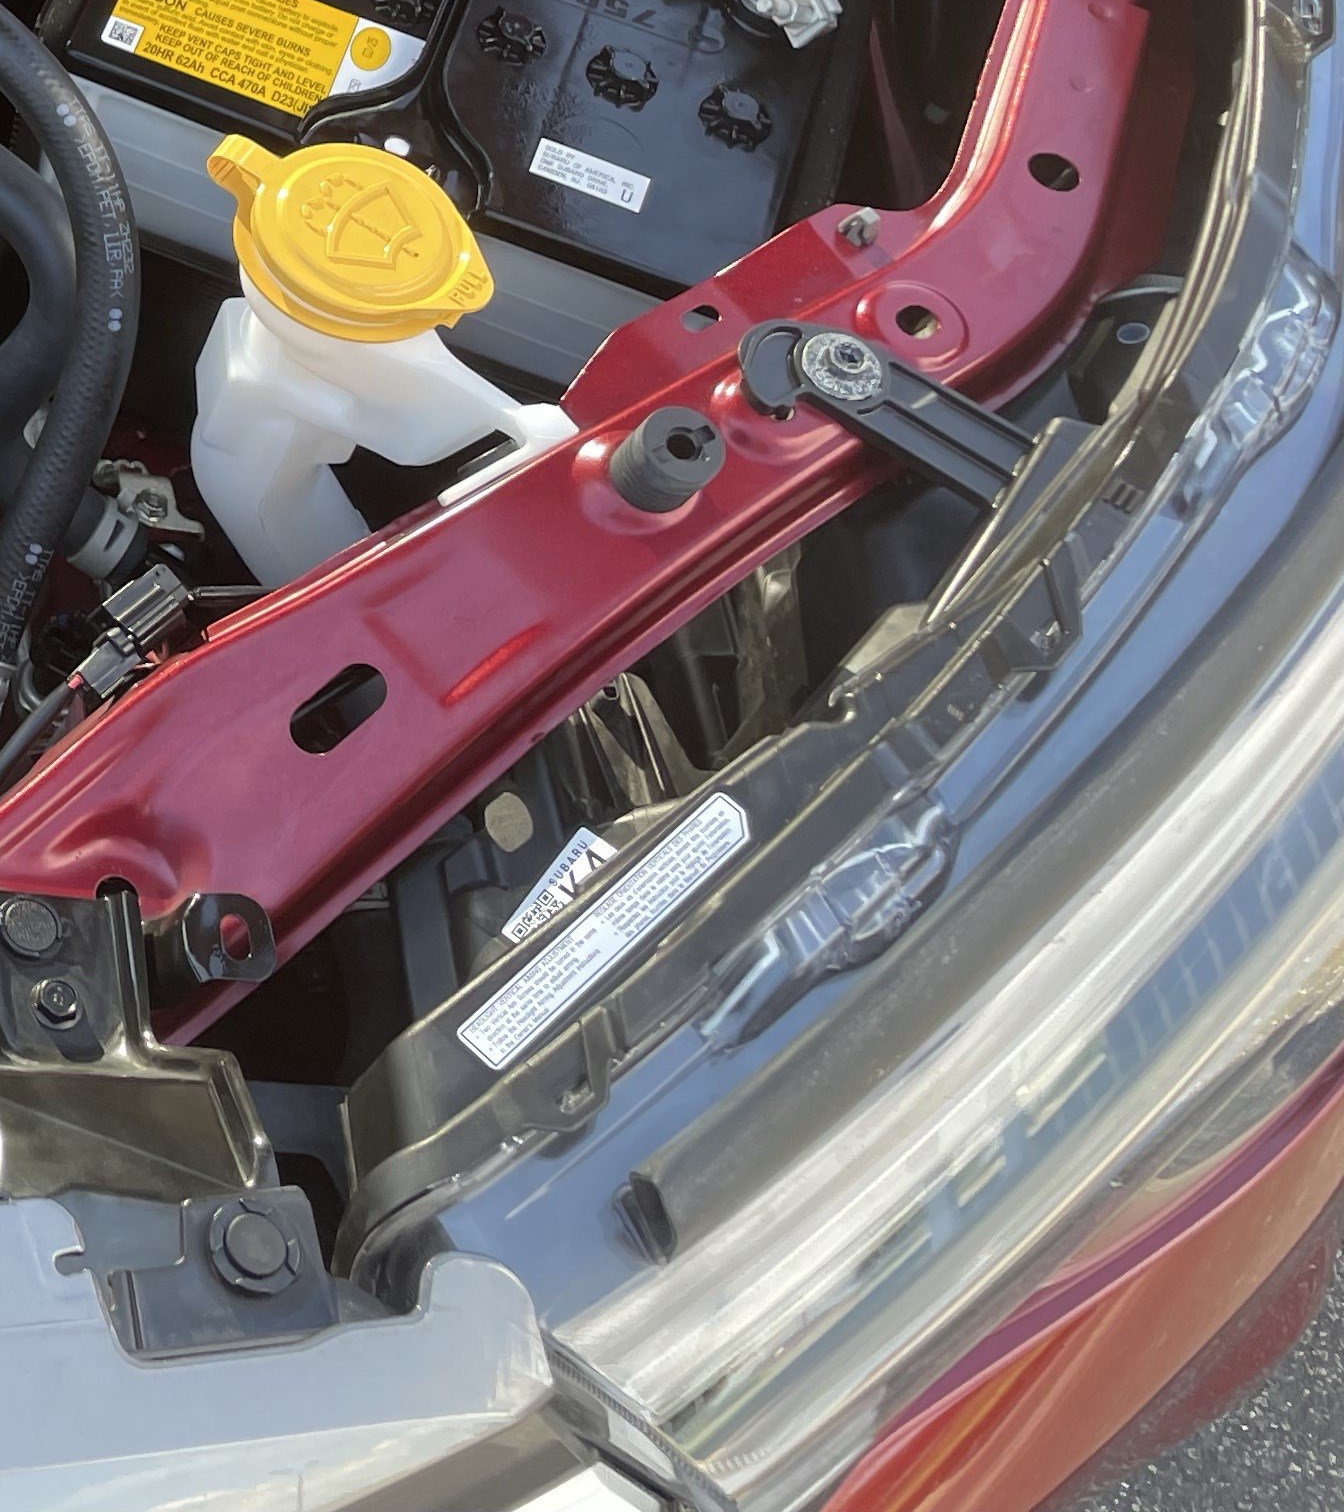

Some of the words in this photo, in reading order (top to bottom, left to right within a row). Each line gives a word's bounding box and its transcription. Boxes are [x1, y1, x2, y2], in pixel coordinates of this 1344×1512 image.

[194, 7, 234, 27] CAUSES
[235, 22, 275, 42] SEVERE
[275, 37, 311, 56] BURNS
[142, 42, 174, 61] 20HR
[175, 54, 205, 72] 62Ah
[209, 67, 237, 84] CCA
[236, 77, 268, 96] 470A
[154, 33, 182, 48] KEEP
[181, 43, 203, 57] OUT
[204, 52, 220, 63] OF
[220, 58, 255, 76] REACH
[256, 71, 270, 82] OF
[158, 23, 186, 39] KEEP
[186, 34, 213, 49] VENT
[213, 44, 241, 60] CAPS
[242, 55, 272, 72] TIGHT
[272, 66, 295, 80] AND
[296, 75, 327, 93] LEVEL
[447, 271, 489, 309] PULL
[548, 839, 590, 887] SUBARU
